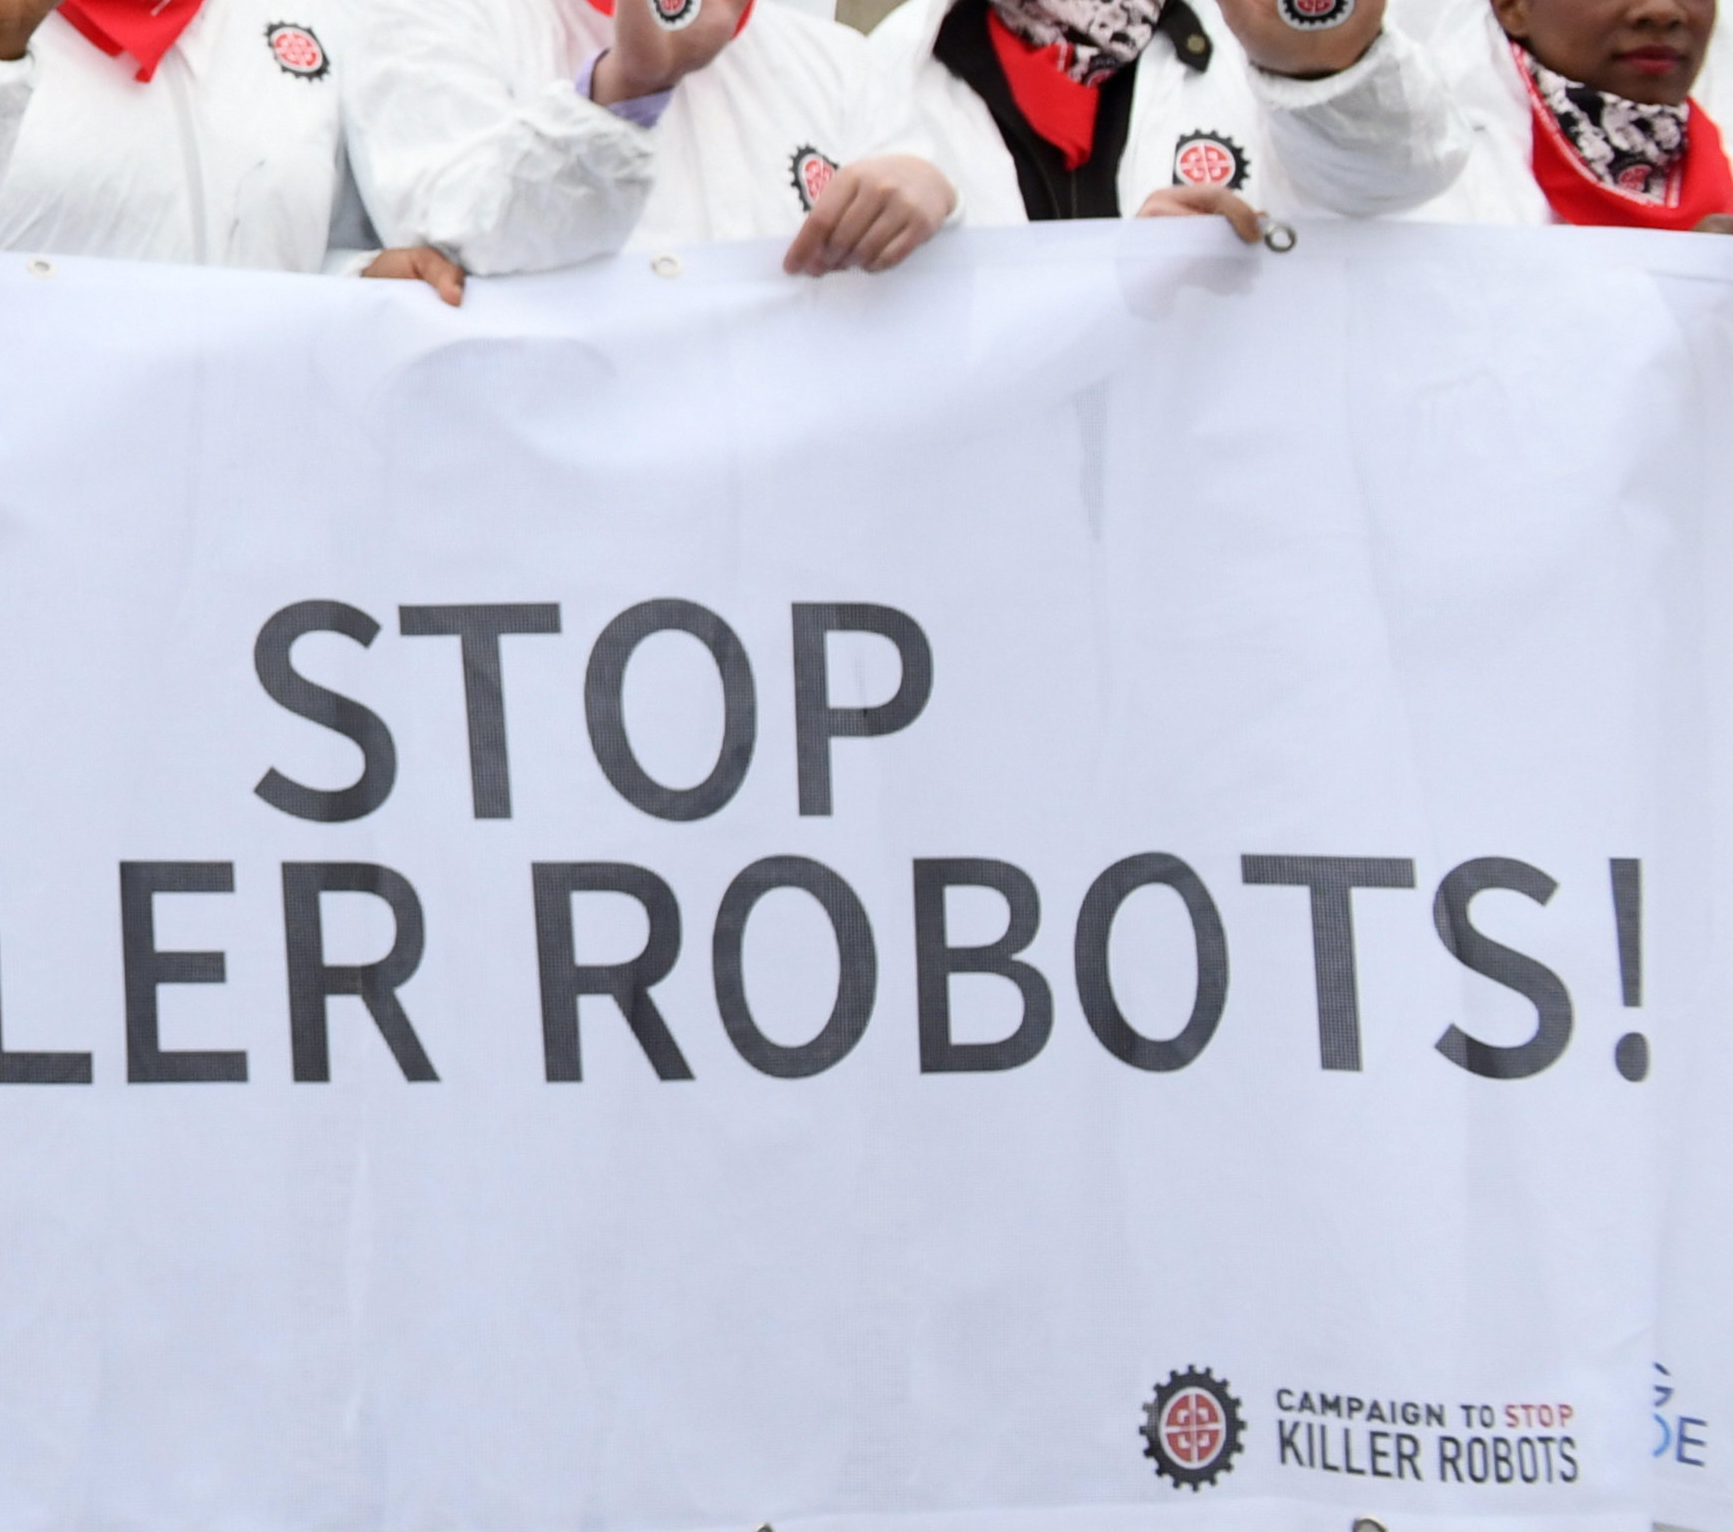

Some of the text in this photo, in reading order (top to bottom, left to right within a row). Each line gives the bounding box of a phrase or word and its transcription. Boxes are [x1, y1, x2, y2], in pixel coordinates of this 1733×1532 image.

[252, 598, 934, 823] STOP
[531, 852, 1650, 1083] ROBOTS!
[1276, 1388, 1574, 1428] CAMPAIGN TO STOP
[1277, 1419, 1578, 1484] KILLER ROBOTS
